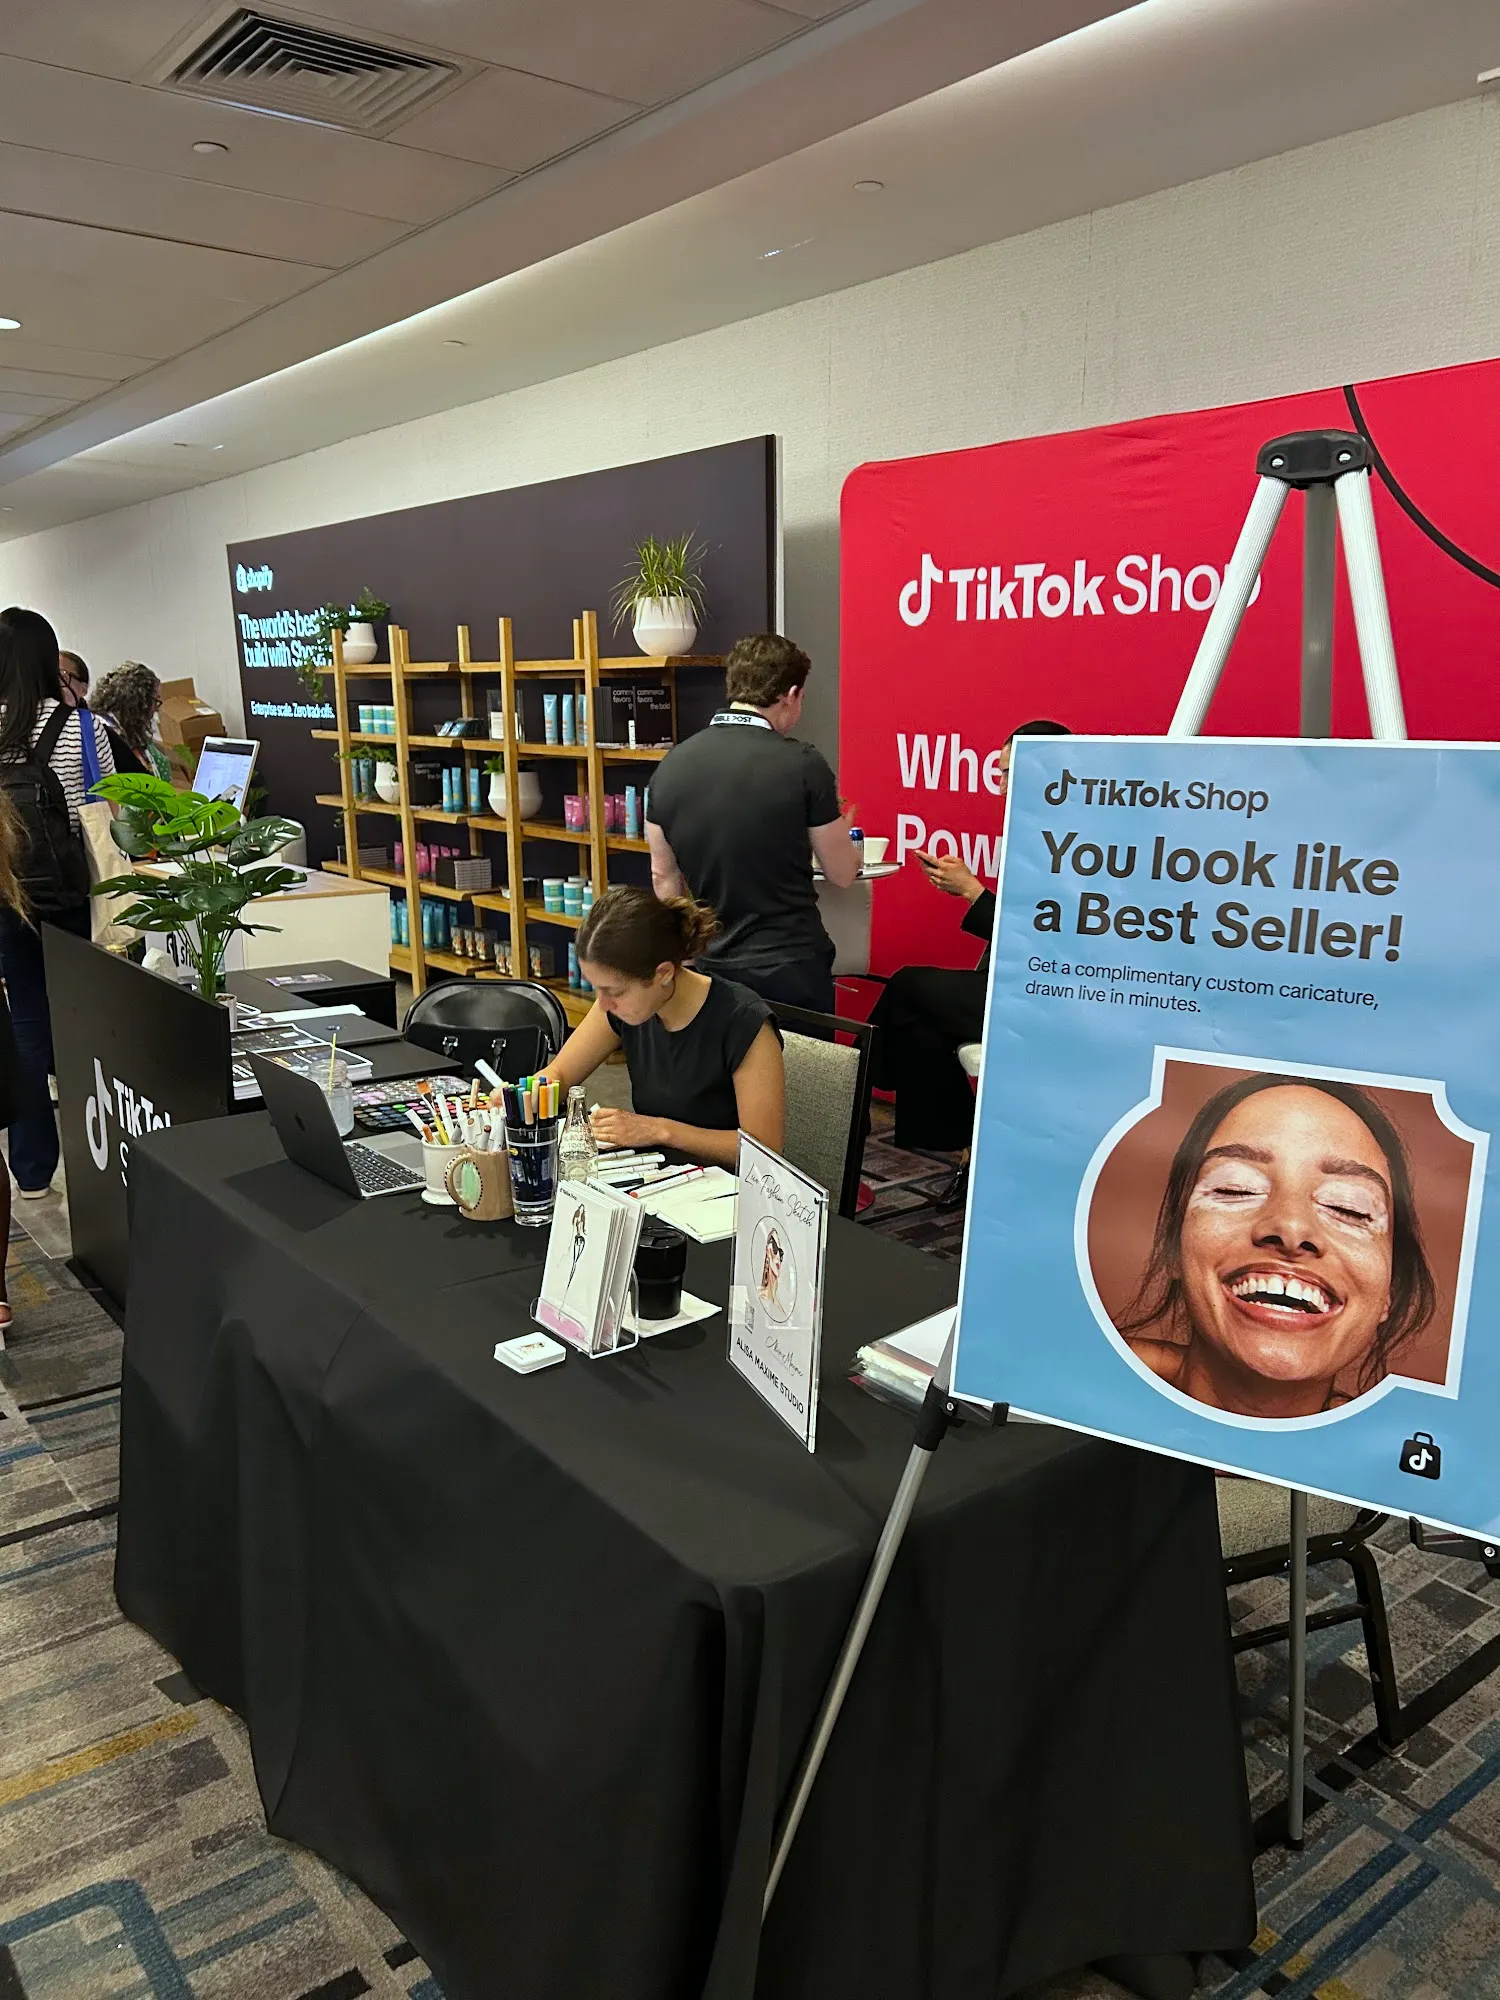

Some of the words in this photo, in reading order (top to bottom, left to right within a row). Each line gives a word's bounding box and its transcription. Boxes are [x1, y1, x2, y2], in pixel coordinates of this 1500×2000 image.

[246, 566, 273, 592] shopify
[948, 559, 1105, 621] TikTok
[238, 613, 260, 639] The
[259, 610, 295, 638] world's
[243, 641, 269, 667] build
[267, 641, 292, 667] with
[732, 715, 752, 723] POST
[1080, 778, 1182, 809] TikTok
[1184, 781, 1270, 818] Shop
[1041, 829, 1137, 879] You
[1150, 836, 1279, 889] look
[1292, 841, 1400, 896] like
[1033, 898, 1062, 933] a
[1076, 891, 1199, 945] Best
[1211, 901, 1403, 962] Seller!
[1025, 980, 1075, 1001] drawn
[1078, 984, 1106, 1002] live
[1110, 987, 1124, 1005] in
[1128, 990, 1202, 1014] minutes.
[1027, 956, 1057, 974] Get
[1061, 963, 1071, 976] a
[1075, 963, 1202, 991] complimentary
[1206, 976, 1274, 997] custom
[1279, 981, 1379, 1010] caricature,
[112, 1077, 171, 1138] TikTo
[736, 1337, 754, 1361] ALISA
[754, 1354, 779, 1389] MAXIME
[779, 1382, 804, 1414] STUDIO
